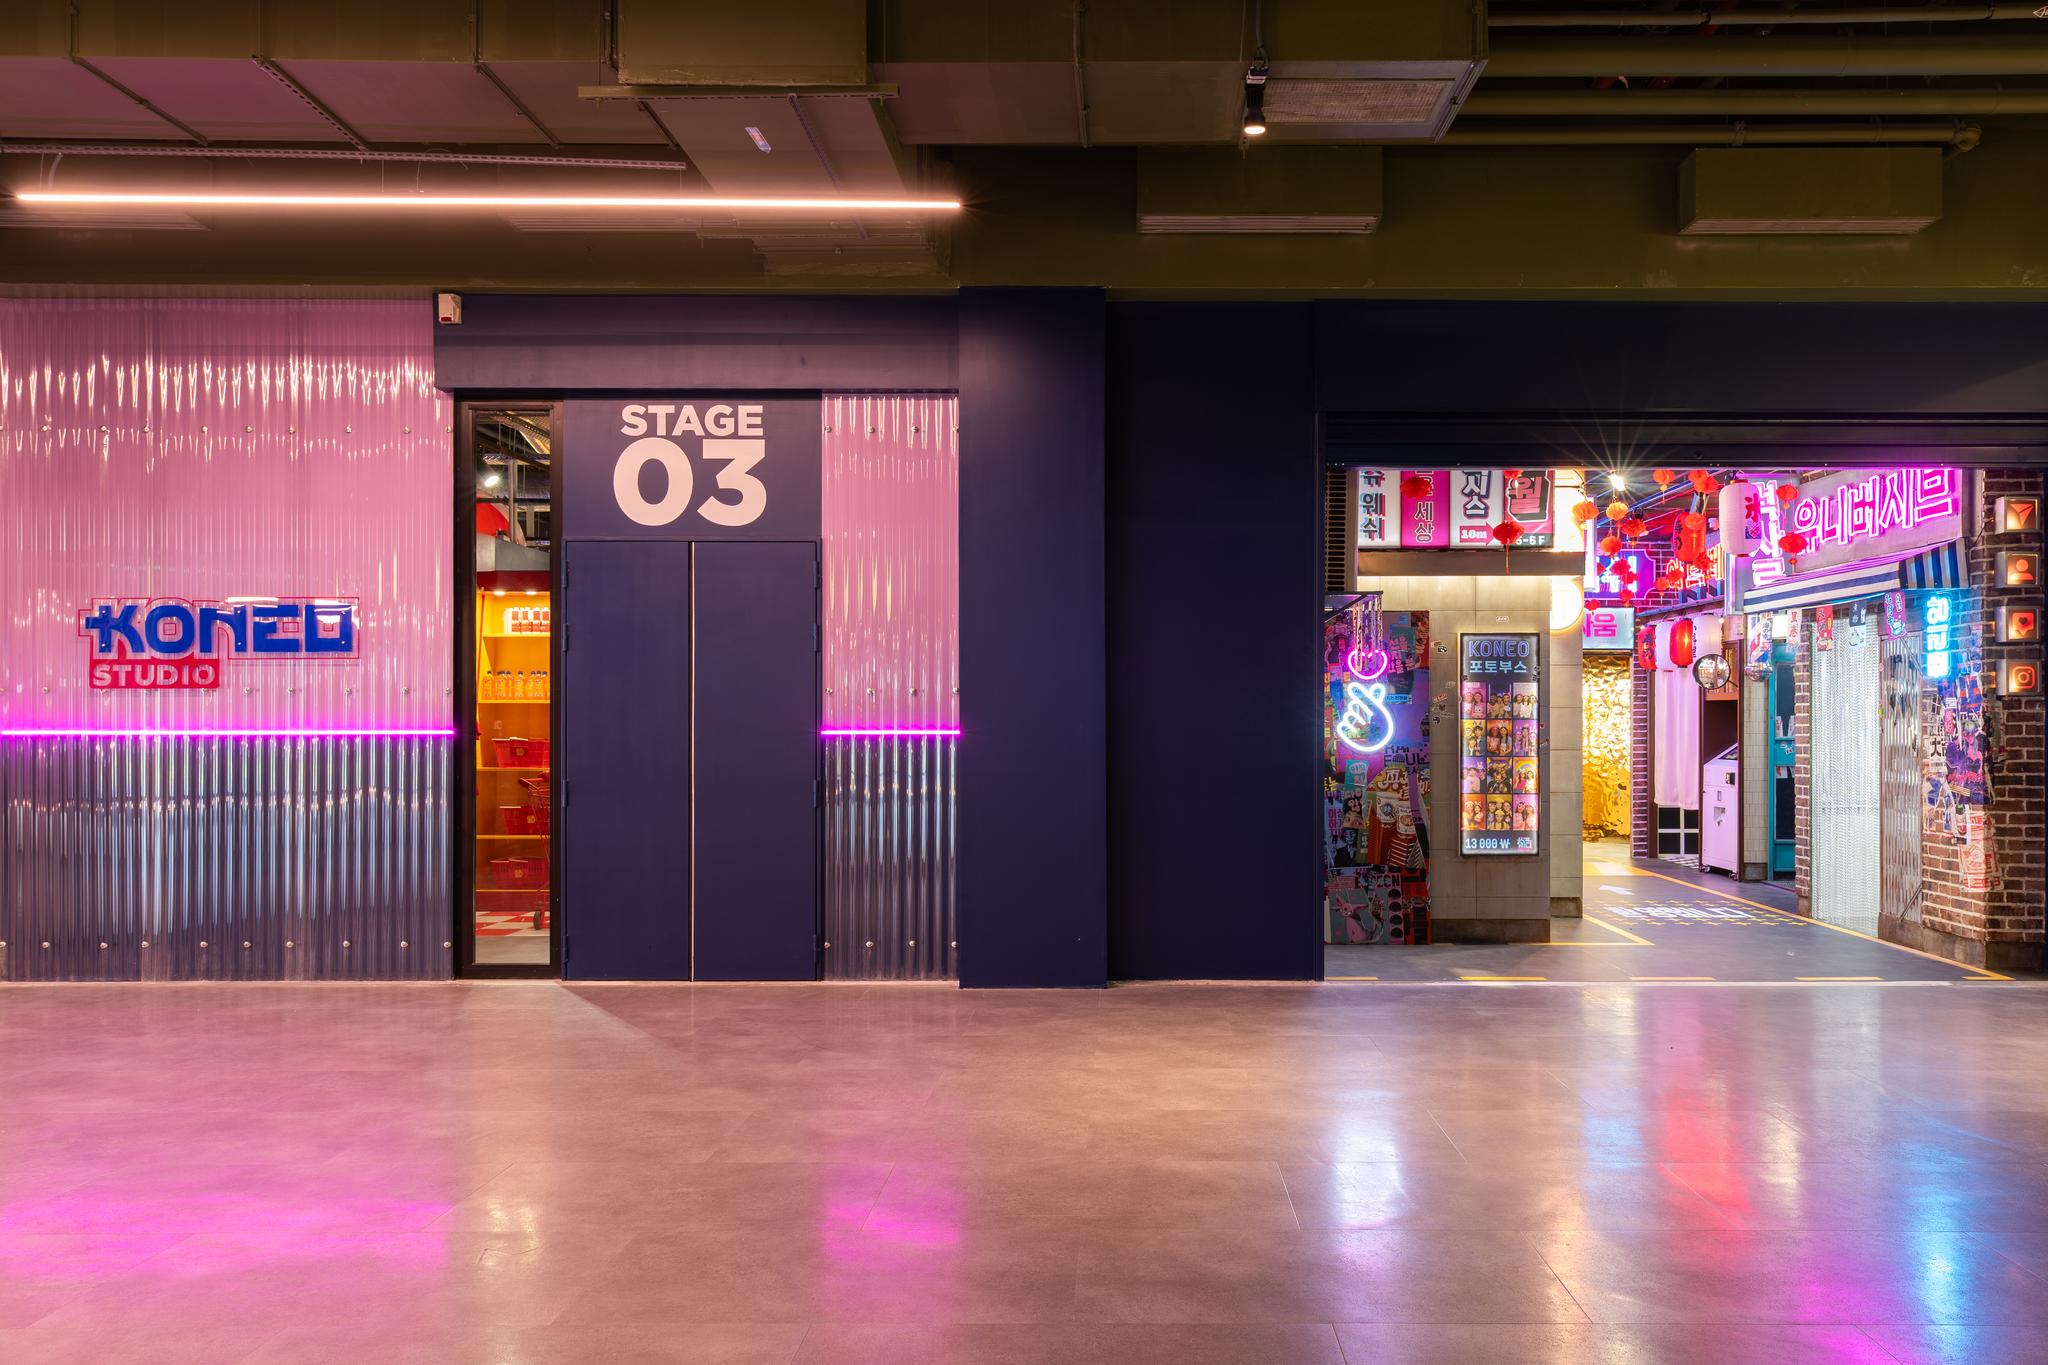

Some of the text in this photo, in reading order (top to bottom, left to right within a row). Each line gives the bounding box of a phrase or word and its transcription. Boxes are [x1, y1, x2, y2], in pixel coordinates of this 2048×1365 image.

[620, 405, 765, 437] STAGE
[613, 437, 768, 527] 03
[1461, 529, 1488, 539] 10m
[85, 604, 353, 653] KONEO
[1468, 640, 1530, 658] KONEO
[92, 663, 217, 687] STUDIO
[1469, 660, 1528, 674] 포토부스
[1465, 838, 1477, 849] 13
